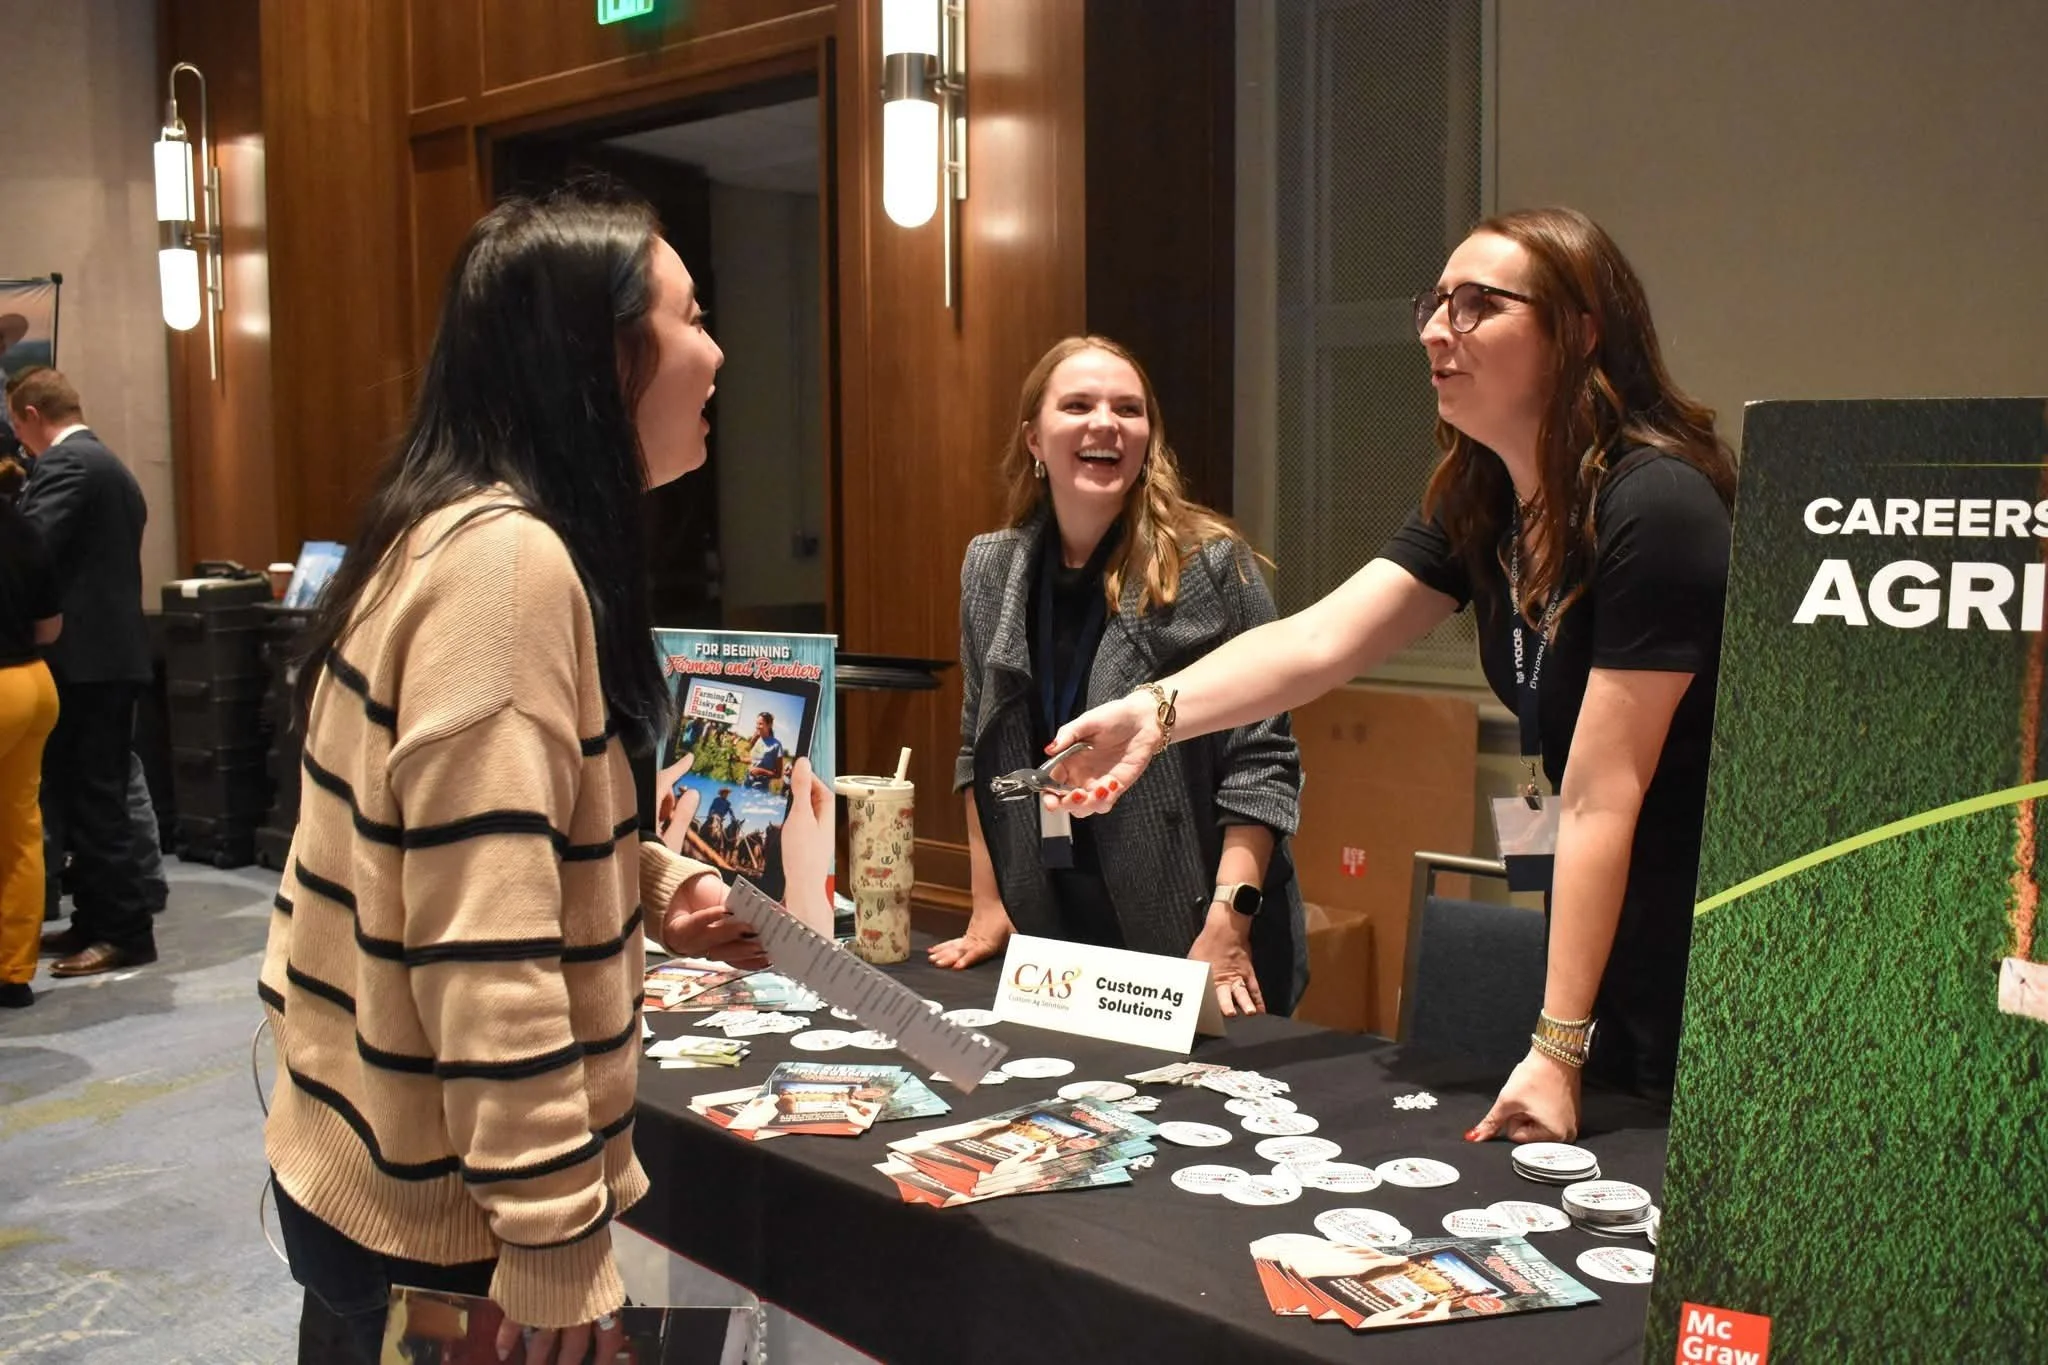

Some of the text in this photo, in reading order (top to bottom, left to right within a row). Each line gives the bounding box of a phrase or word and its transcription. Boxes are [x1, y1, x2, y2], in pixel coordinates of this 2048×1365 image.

[1792, 559, 2046, 632] AGRI
[695, 643, 790, 658] FOR BEGINNING
[666, 655, 822, 681] Farmers and Ranchers
[693, 696, 716, 710] Risky
[695, 687, 726, 702] Farming
[691, 705, 726, 720] Business
[1014, 963, 1075, 1000] CAS
[1096, 977, 1185, 1008] Custom Ag
[1098, 997, 1173, 1021] Solutions
[1686, 1310, 1733, 1339] Mc
[1682, 1336, 1759, 1365] Graw
